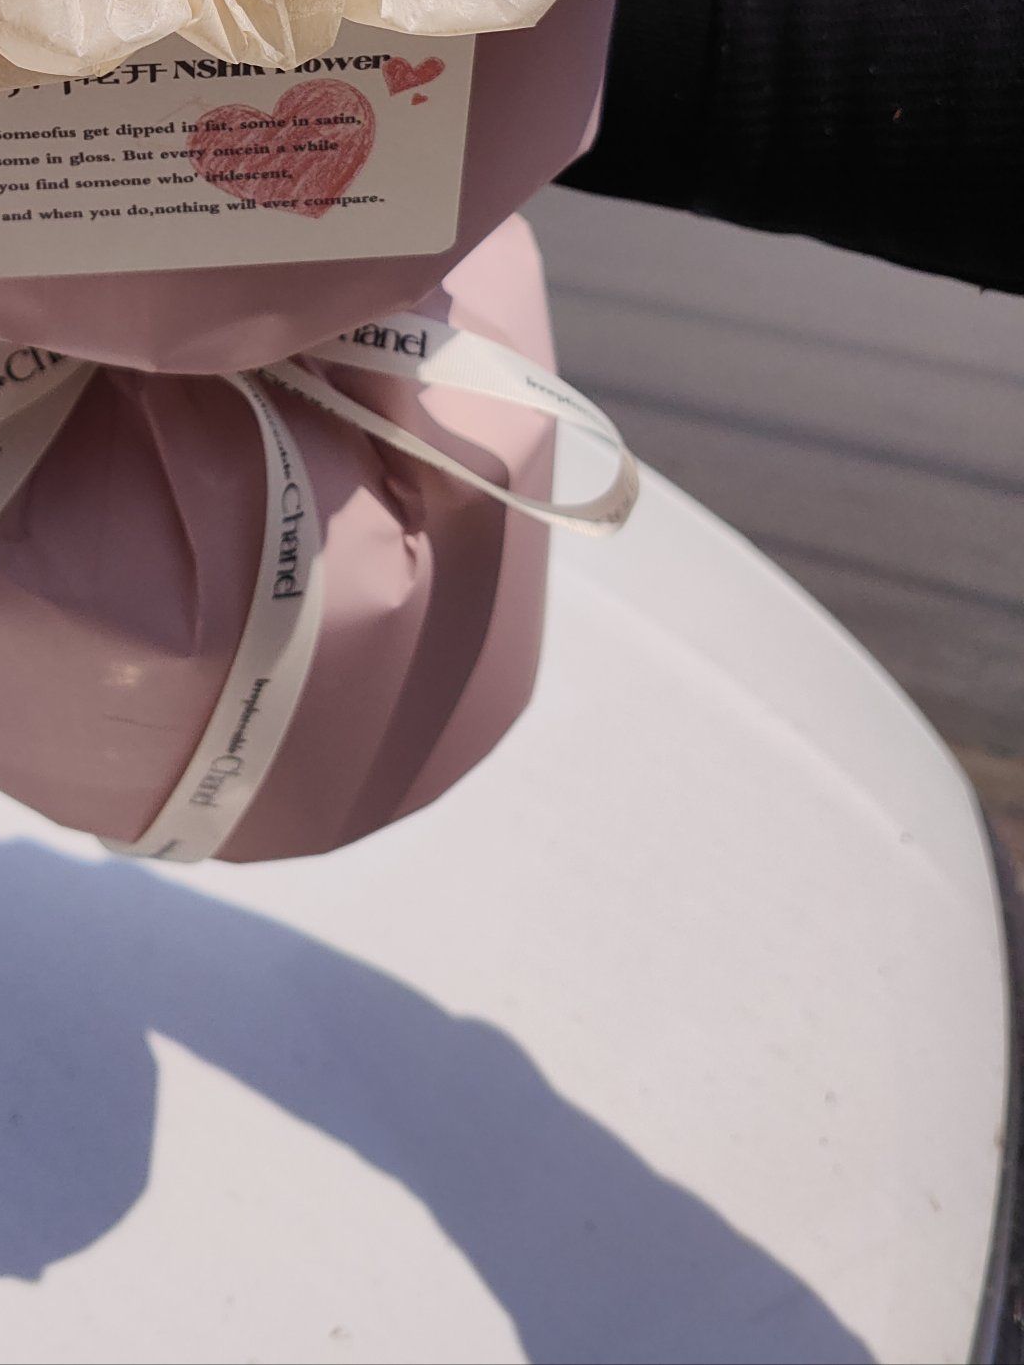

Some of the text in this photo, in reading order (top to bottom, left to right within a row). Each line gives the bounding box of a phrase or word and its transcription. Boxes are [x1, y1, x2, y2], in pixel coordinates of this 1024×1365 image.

[275, 54, 391, 74] ower
[83, 126, 110, 141] get
[116, 121, 175, 139] dipped
[181, 121, 199, 133] in
[239, 118, 287, 131] some
[291, 116, 310, 127] in
[315, 113, 362, 126] satin,
[46, 153, 63, 165] in
[69, 151, 116, 166] gloss.
[122, 149, 154, 162] But
[160, 147, 205, 160] every
[277, 145, 286, 153] a
[292, 140, 339, 153] while
[36, 178, 70, 191] find
[75, 175, 152, 189] someone
[2, 209, 33, 222] and
[39, 208, 84, 220] when
[90, 207, 121, 221] you
[226, 198, 257, 211] will
[262, 199, 300, 209] ever
[304, 193, 385, 209] compare.
